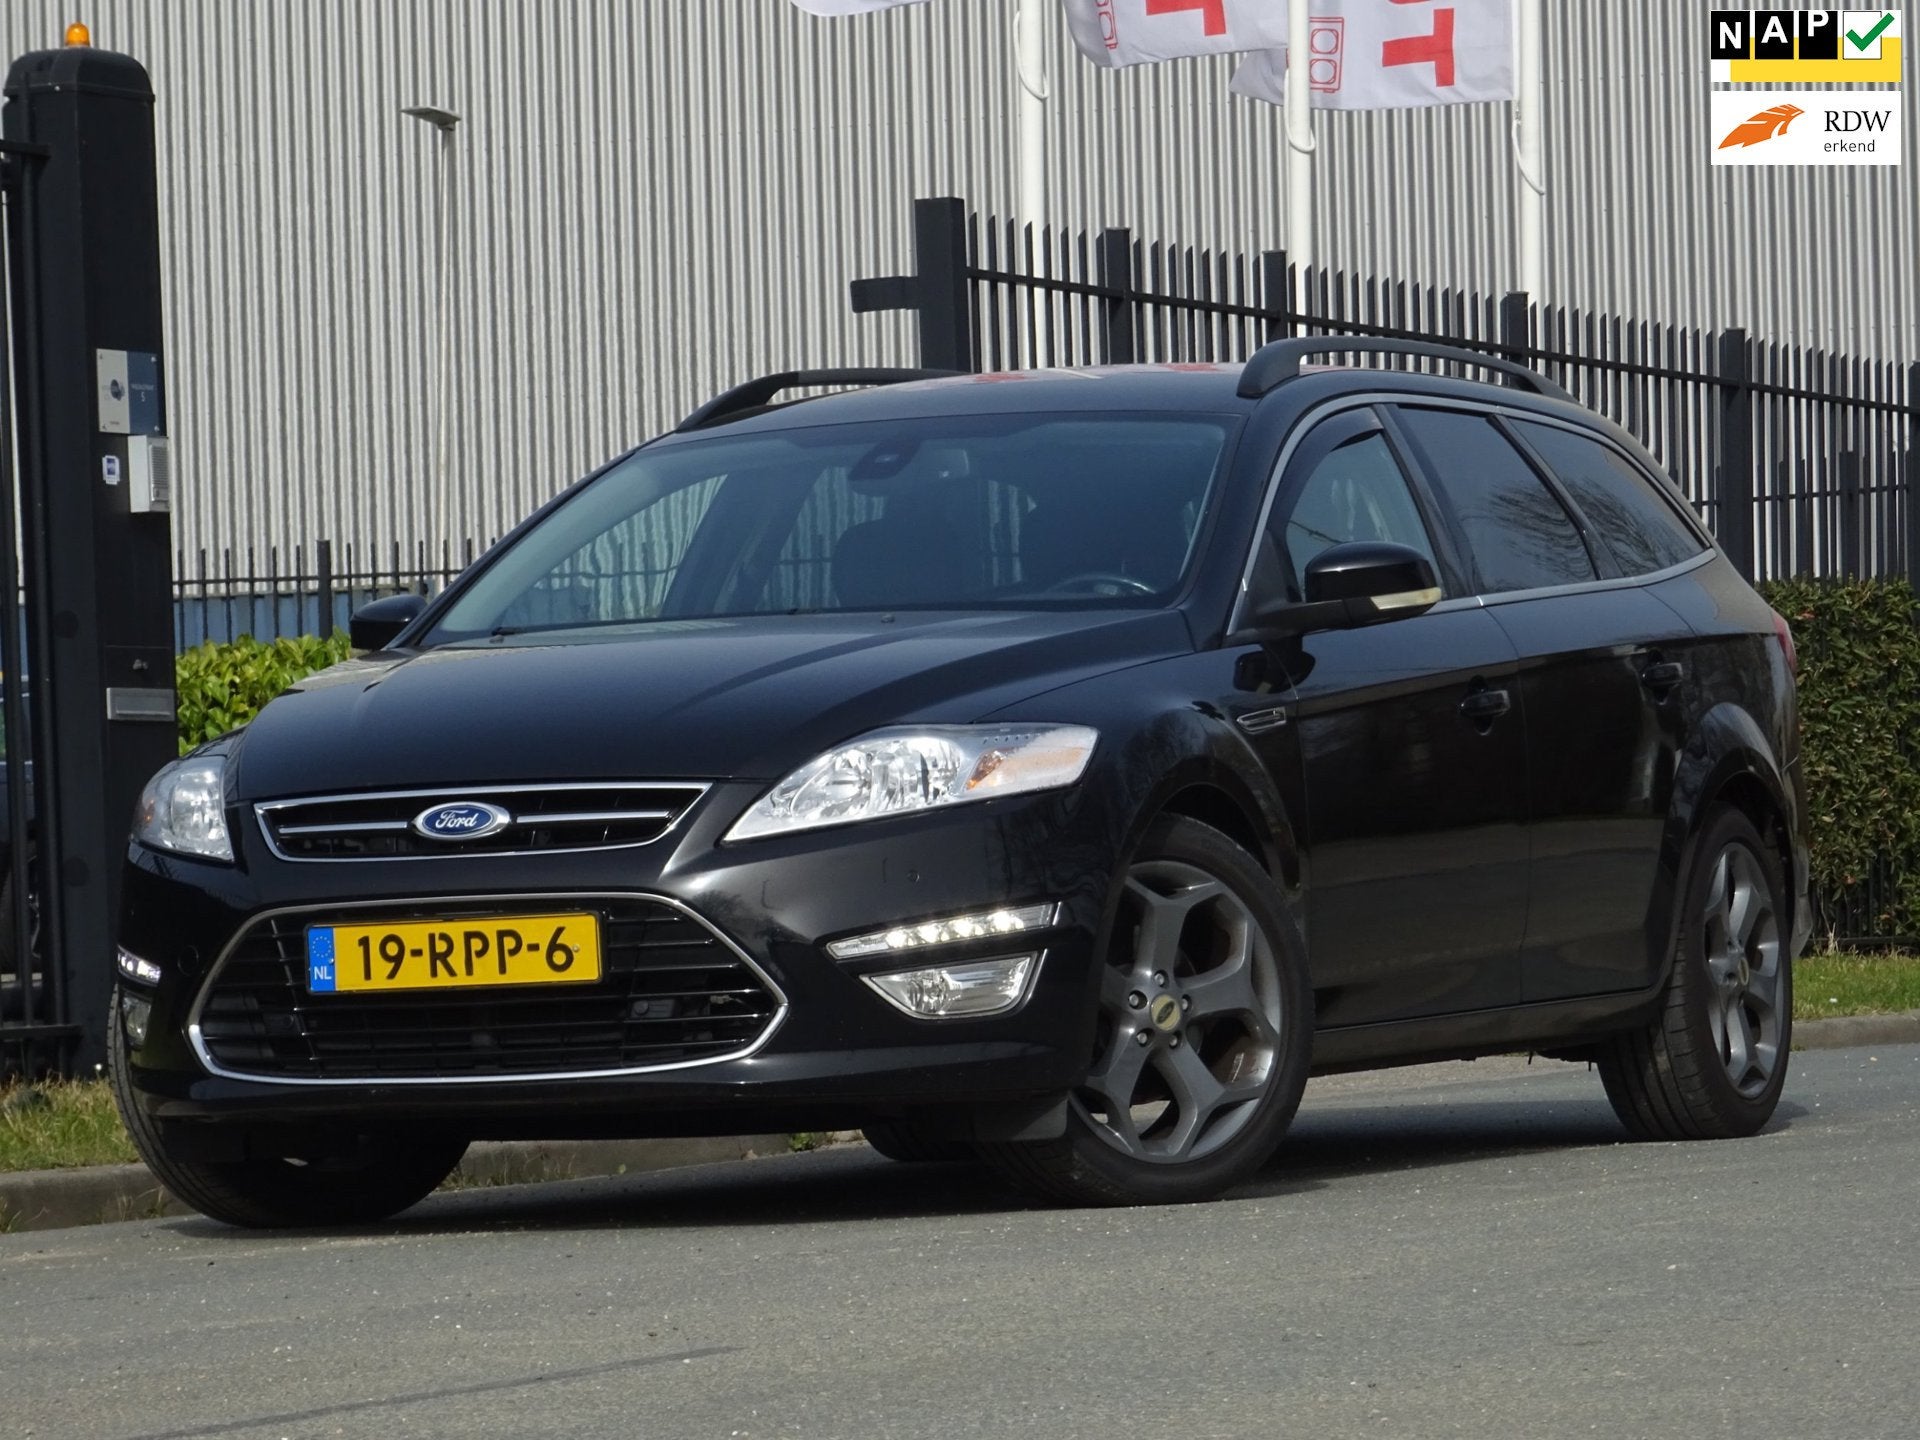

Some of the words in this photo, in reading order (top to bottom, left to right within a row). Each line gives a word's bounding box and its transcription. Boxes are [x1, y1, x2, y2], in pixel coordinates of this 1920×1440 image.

[435, 809, 479, 829] Ford
[357, 926, 575, 981] 19-RPP-6
[313, 966, 332, 980] NL
